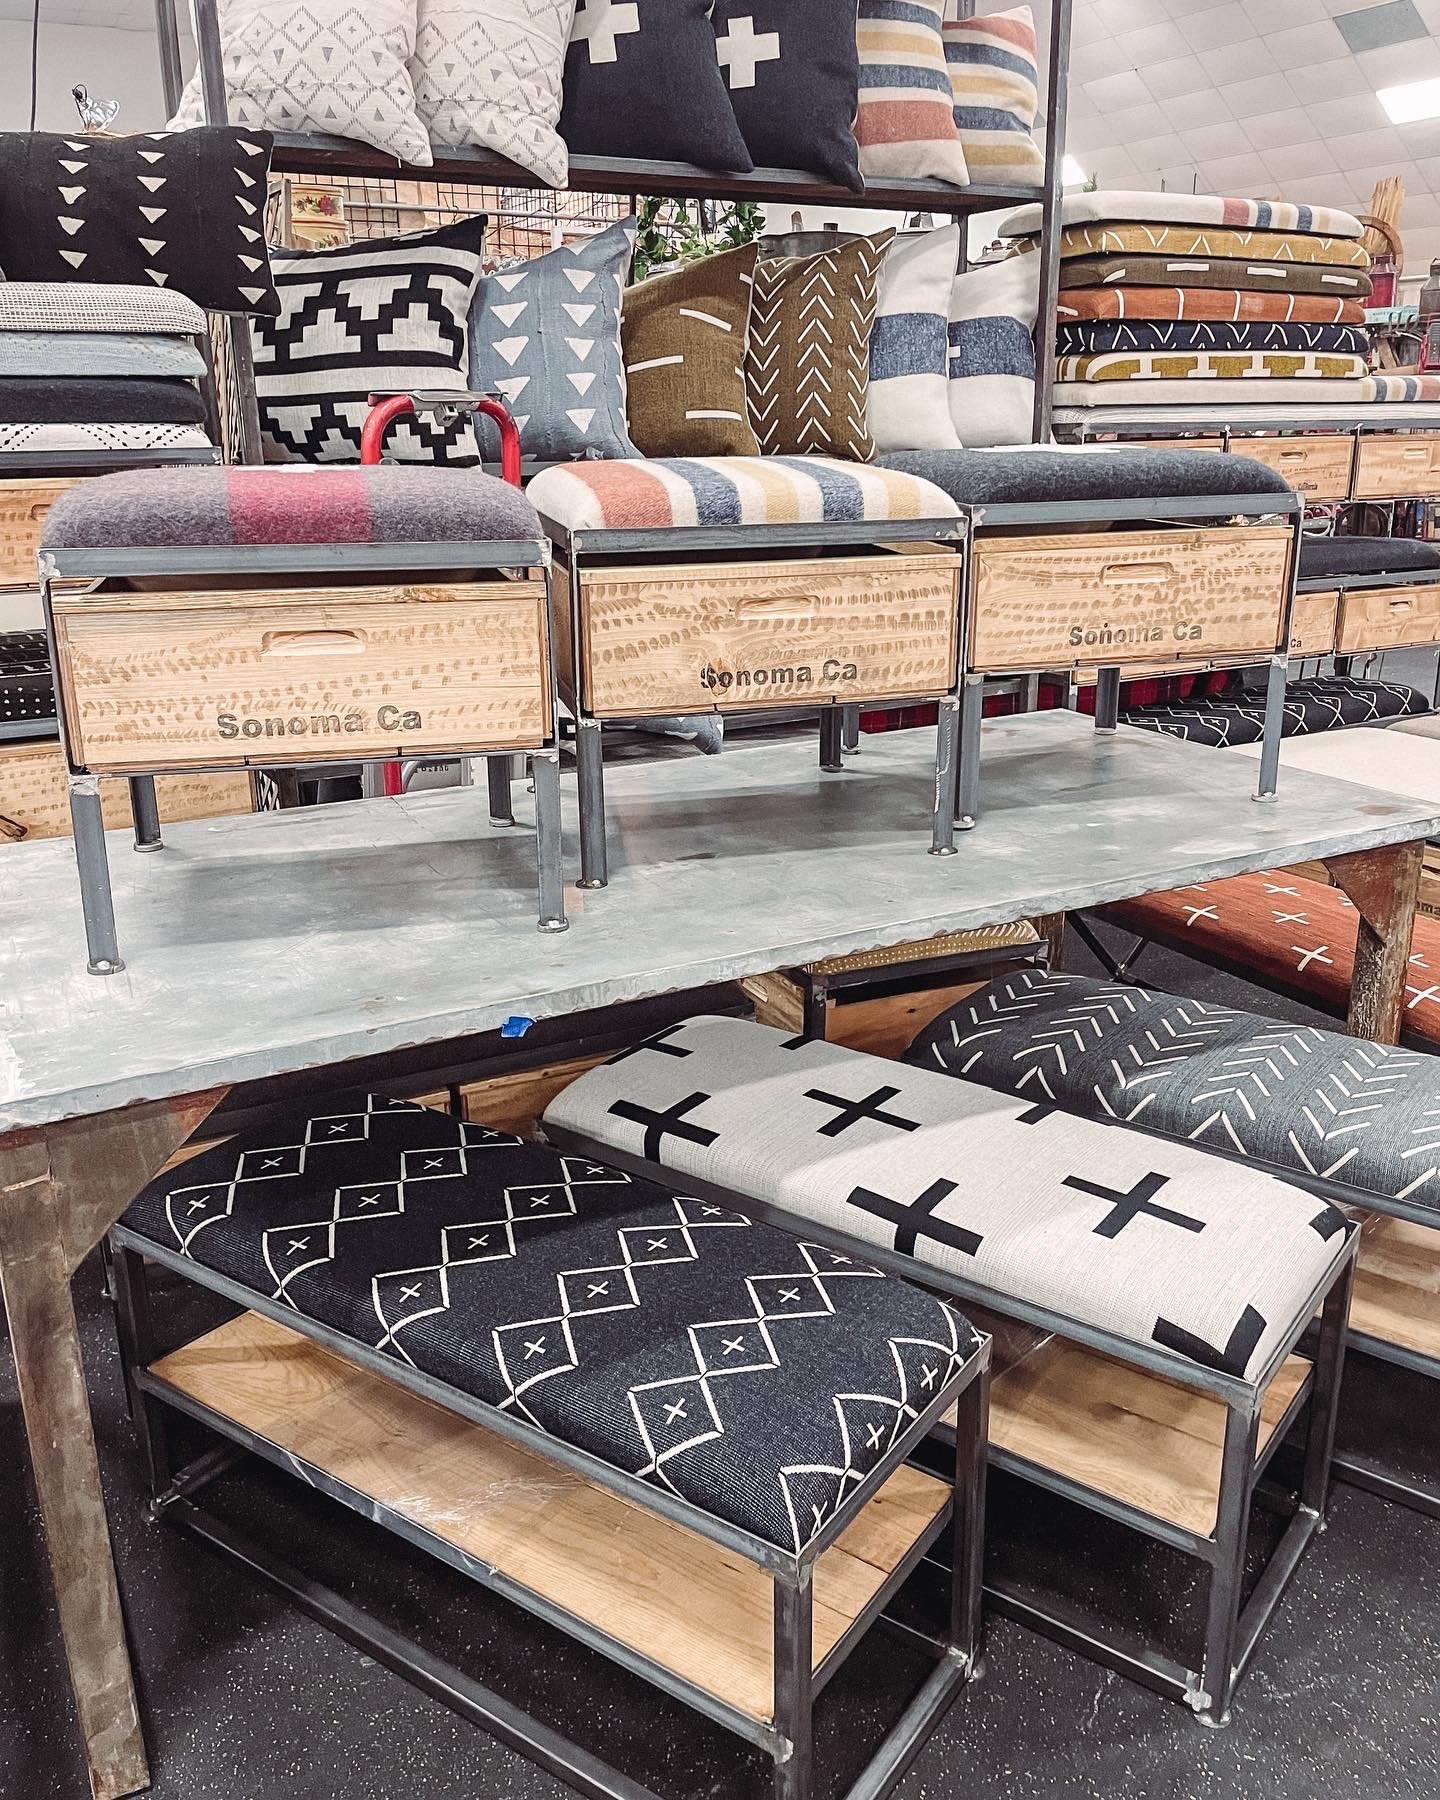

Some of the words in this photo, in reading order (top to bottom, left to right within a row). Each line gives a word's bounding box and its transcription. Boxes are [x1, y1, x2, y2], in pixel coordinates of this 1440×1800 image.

[1069, 625, 1164, 646] Sonoma
[1173, 621, 1203, 641] Ca
[700, 663, 813, 689] Sonoma
[822, 659, 858, 681] Ca
[217, 713, 364, 739] Sonoma
[377, 705, 423, 731] Ca
